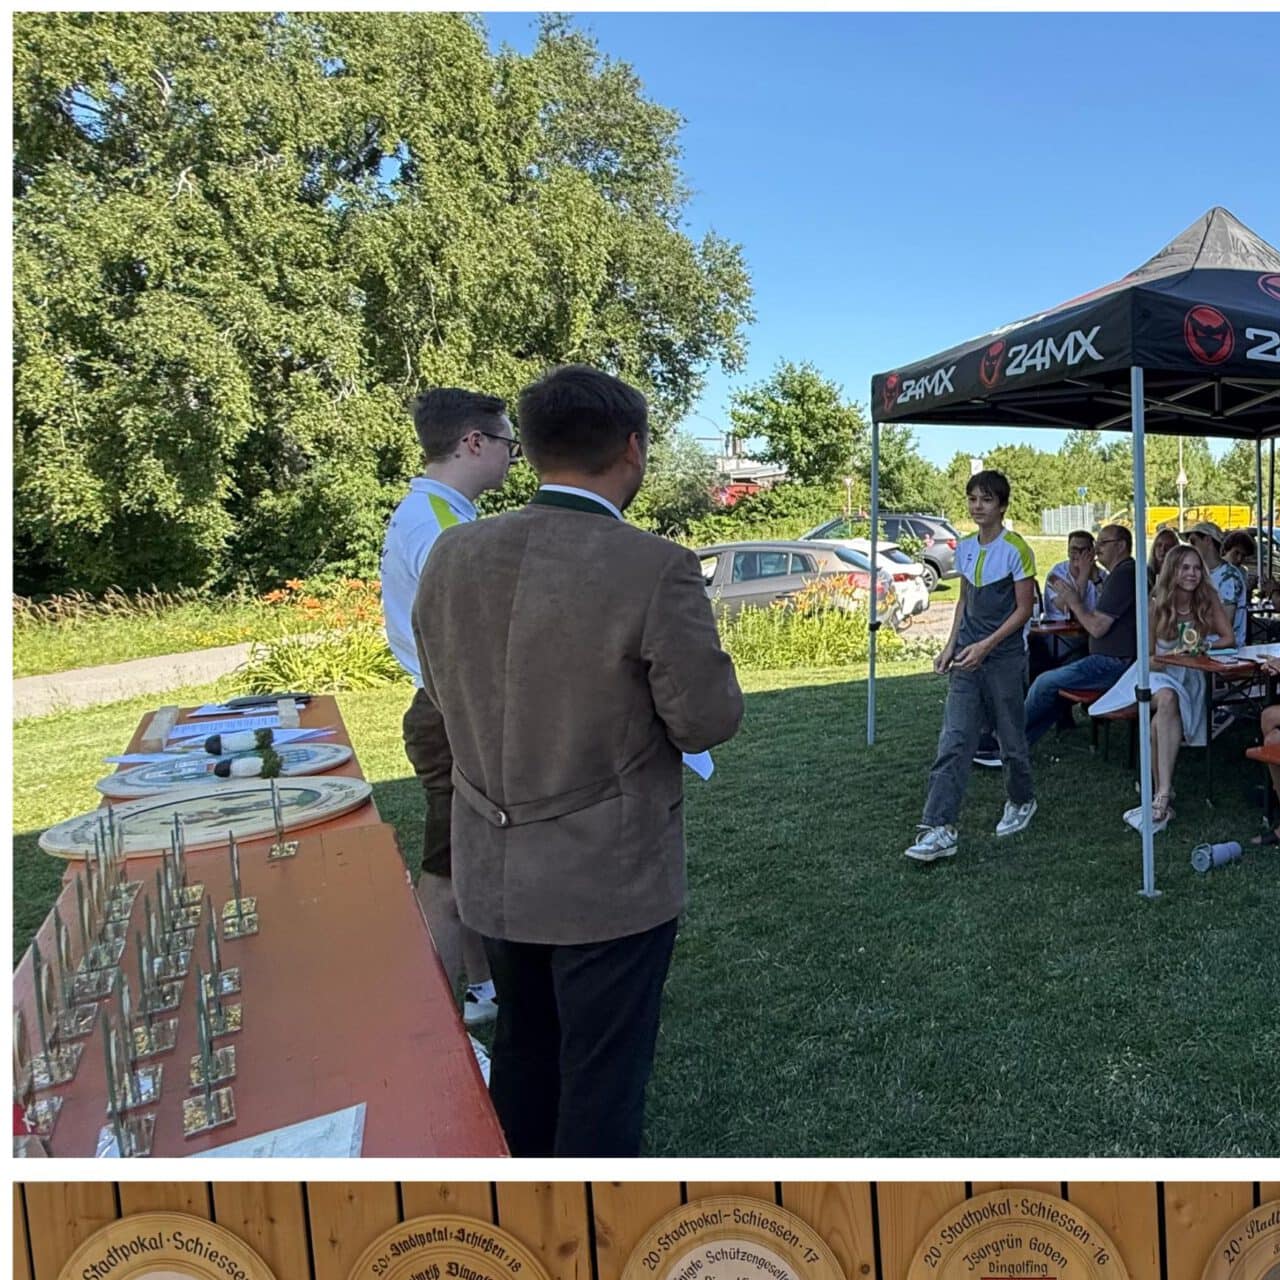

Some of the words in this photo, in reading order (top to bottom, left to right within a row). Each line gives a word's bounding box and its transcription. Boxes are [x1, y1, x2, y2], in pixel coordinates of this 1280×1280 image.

[1006, 326, 1104, 376] 24MX
[897, 366, 956, 404] 24MX
[643, 1252, 660, 1271] 20
[802, 1248, 820, 1265] 17
[924, 1246, 942, 1268] 20
[1093, 1247, 1110, 1265] 16
[1029, 1237, 1068, 1268] Goben
[989, 1261, 1048, 1277] Dingolfing
